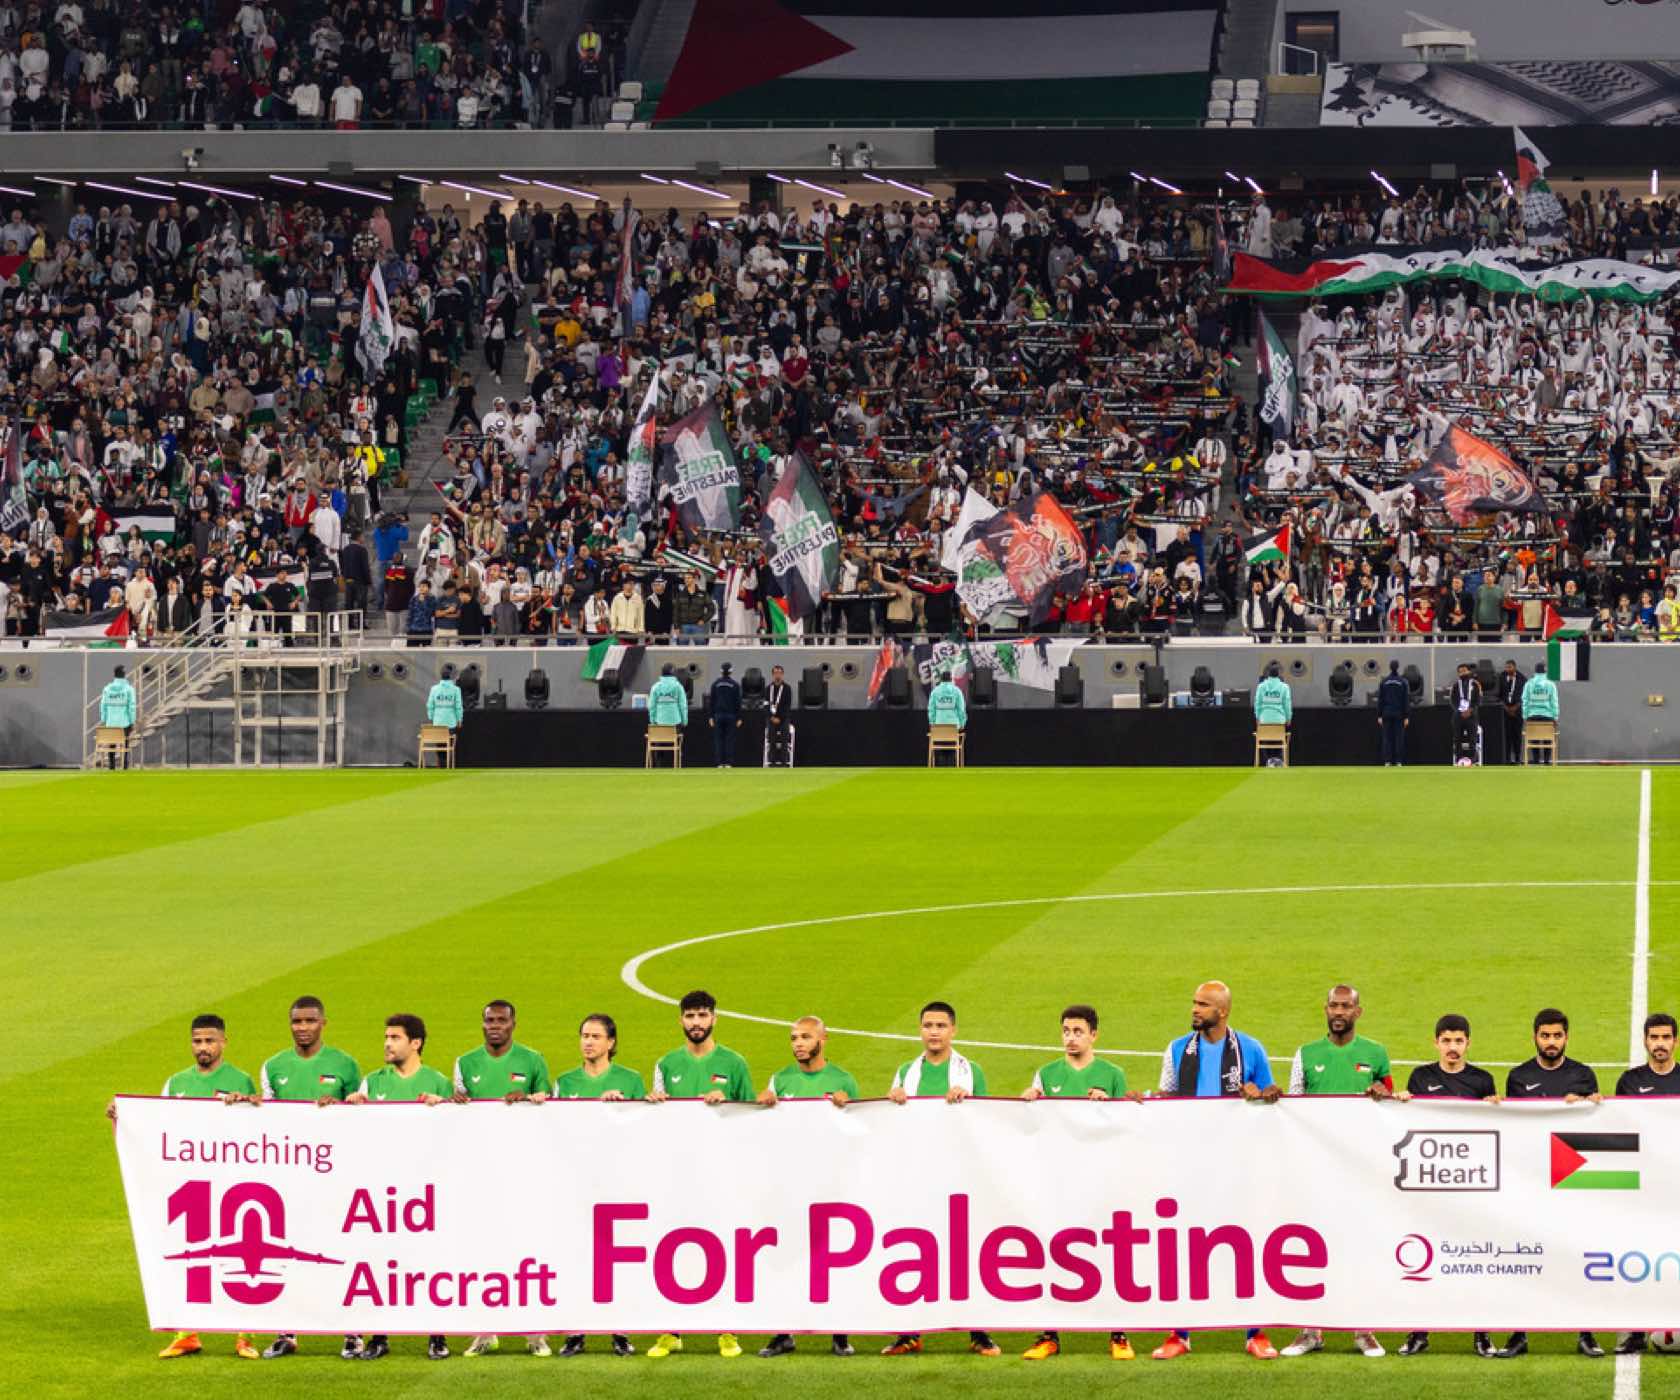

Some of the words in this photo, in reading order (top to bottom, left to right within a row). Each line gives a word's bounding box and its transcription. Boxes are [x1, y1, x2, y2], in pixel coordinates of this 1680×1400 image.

[161, 1132, 333, 1173] Launching
[1420, 1138, 1470, 1160] One
[1419, 1163, 1488, 1184] Heart
[342, 1184, 435, 1233] Aid
[593, 1203, 777, 1305] For
[809, 1194, 1329, 1307] Palestine
[1440, 1241, 1493, 1258] الخيرية
[1494, 1241, 1544, 1258] قطر
[1440, 1263, 1483, 1275] QATAR
[1486, 1263, 1543, 1275] CHARITY
[341, 1258, 557, 1308] Aircraft
